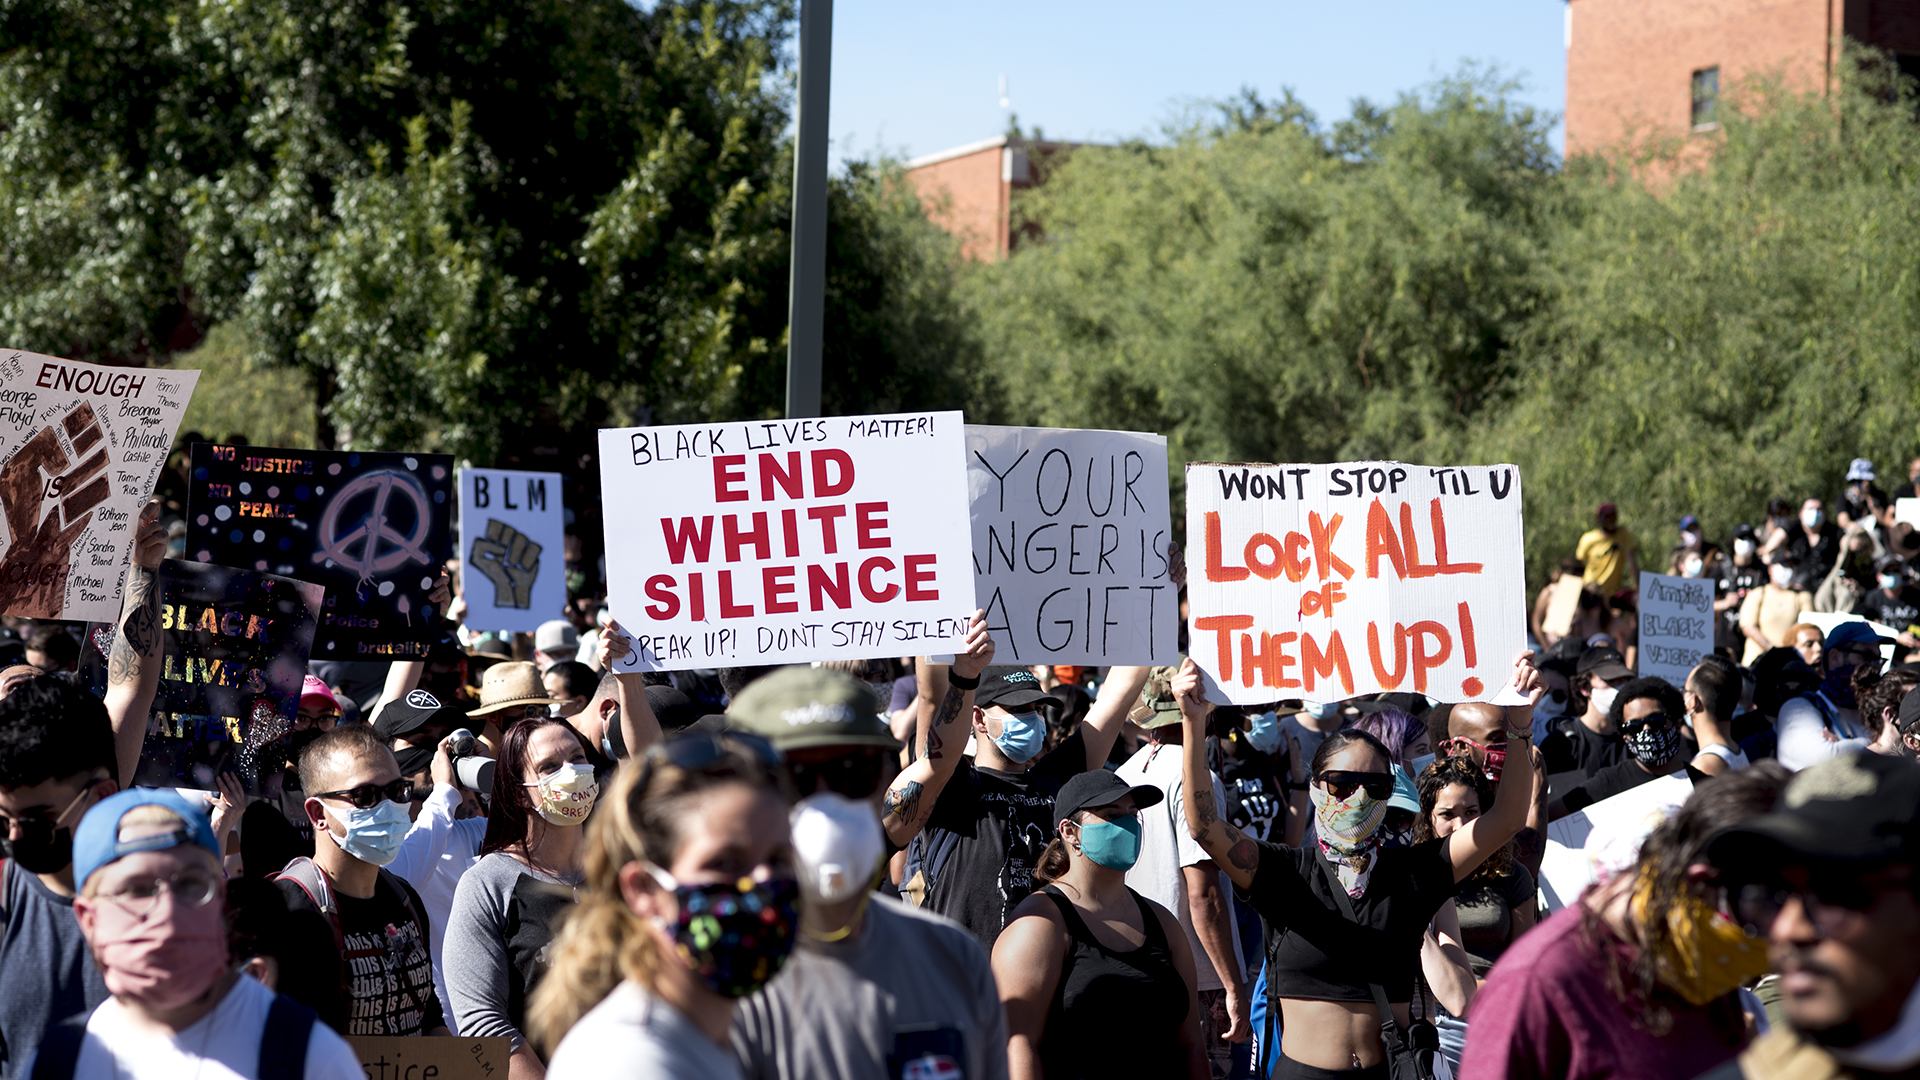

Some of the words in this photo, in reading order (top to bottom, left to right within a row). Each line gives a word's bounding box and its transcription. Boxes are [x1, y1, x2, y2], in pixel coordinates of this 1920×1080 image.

[35, 363, 147, 398] ENOUGH
[0, 389, 37, 410] eorge
[119, 399, 161, 417] Breanna
[0, 407, 36, 431] Floyd
[212, 445, 236, 461] NO
[631, 428, 725, 465] BLACK
[745, 420, 828, 450] LIVES
[848, 416, 935, 438] MATTER!
[240, 457, 314, 475] JUSTICE
[712, 448, 855, 502] END
[974, 448, 1145, 517] YOUR
[40, 476, 64, 500] IS
[208, 483, 232, 499] NO
[474, 475, 546, 511] BLM
[1219, 469, 1310, 501] WONT
[1329, 468, 1407, 497] STOP
[1489, 468, 1511, 500] U
[239, 501, 296, 519] PEACE
[660, 501, 892, 564] WHITE
[1204, 510, 1355, 582] LOCK
[1366, 496, 1484, 580] ALL
[972, 521, 1119, 575] NGER
[1141, 529, 1168, 580] IS
[644, 554, 939, 621] SILENCE
[1647, 577, 1710, 613] Amplify
[162, 604, 275, 643] BLACK
[325, 613, 380, 628] Police
[984, 586, 1019, 660] A
[1037, 586, 1165, 660] GIFT
[1643, 613, 1706, 640] BLACK
[357, 641, 431, 657] brutality
[624, 634, 692, 666] SPEAK
[705, 628, 736, 658] UP!
[831, 621, 885, 647] STAY
[892, 617, 971, 641] SILENT
[1195, 615, 1355, 695] THEM
[1367, 601, 1484, 697] UP!
[164, 654, 269, 694] LIVES
[150, 711, 244, 743] ATTER
[552, 790, 561, 800] I
[571, 784, 597, 802] CAN'T
[352, 997, 383, 1018] this
[386, 994, 398, 1013] is
[350, 1018, 383, 1035] this
[386, 1014, 398, 1034] is
[471, 1043, 494, 1077] BLM
